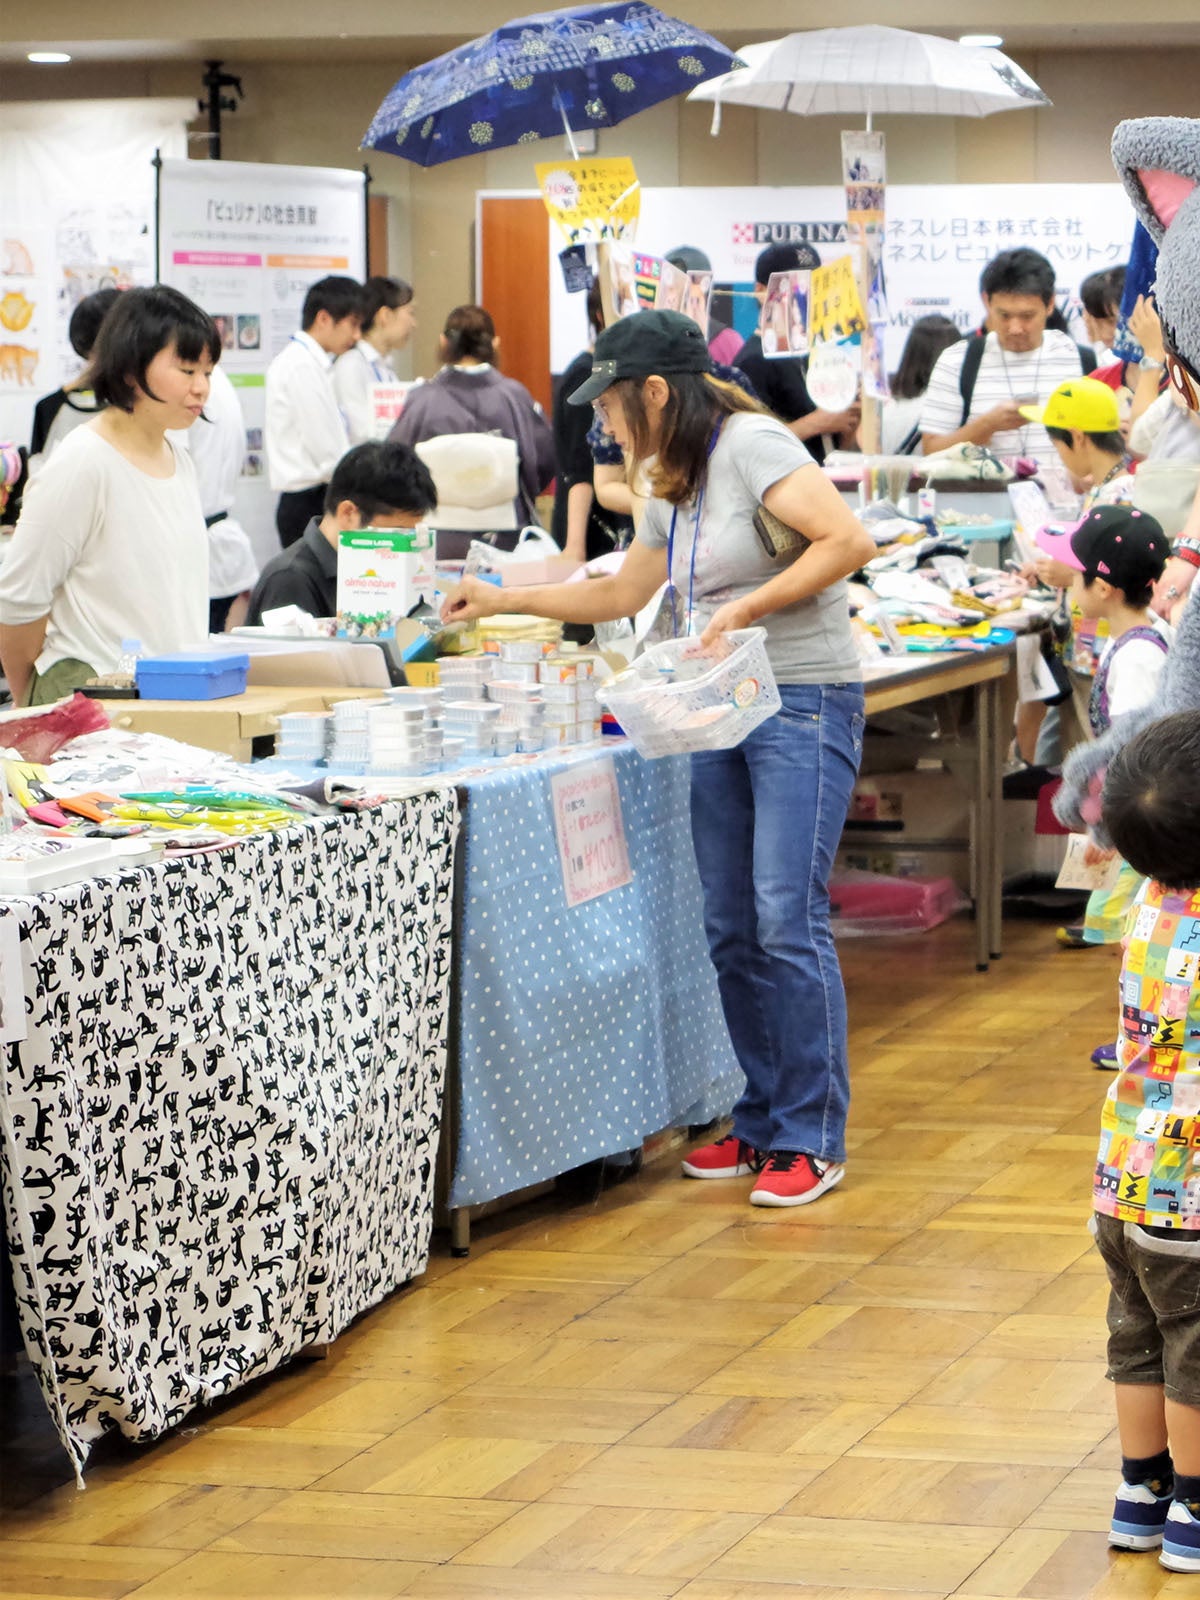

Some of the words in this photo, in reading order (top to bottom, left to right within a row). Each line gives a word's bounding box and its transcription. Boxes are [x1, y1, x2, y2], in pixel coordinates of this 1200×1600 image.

[757, 222, 849, 242] PURINA
[888, 217, 1084, 237] ネスレ日本株式会社
[1047, 243, 1133, 262] ペットケ
[368, 578, 397, 589] nature
